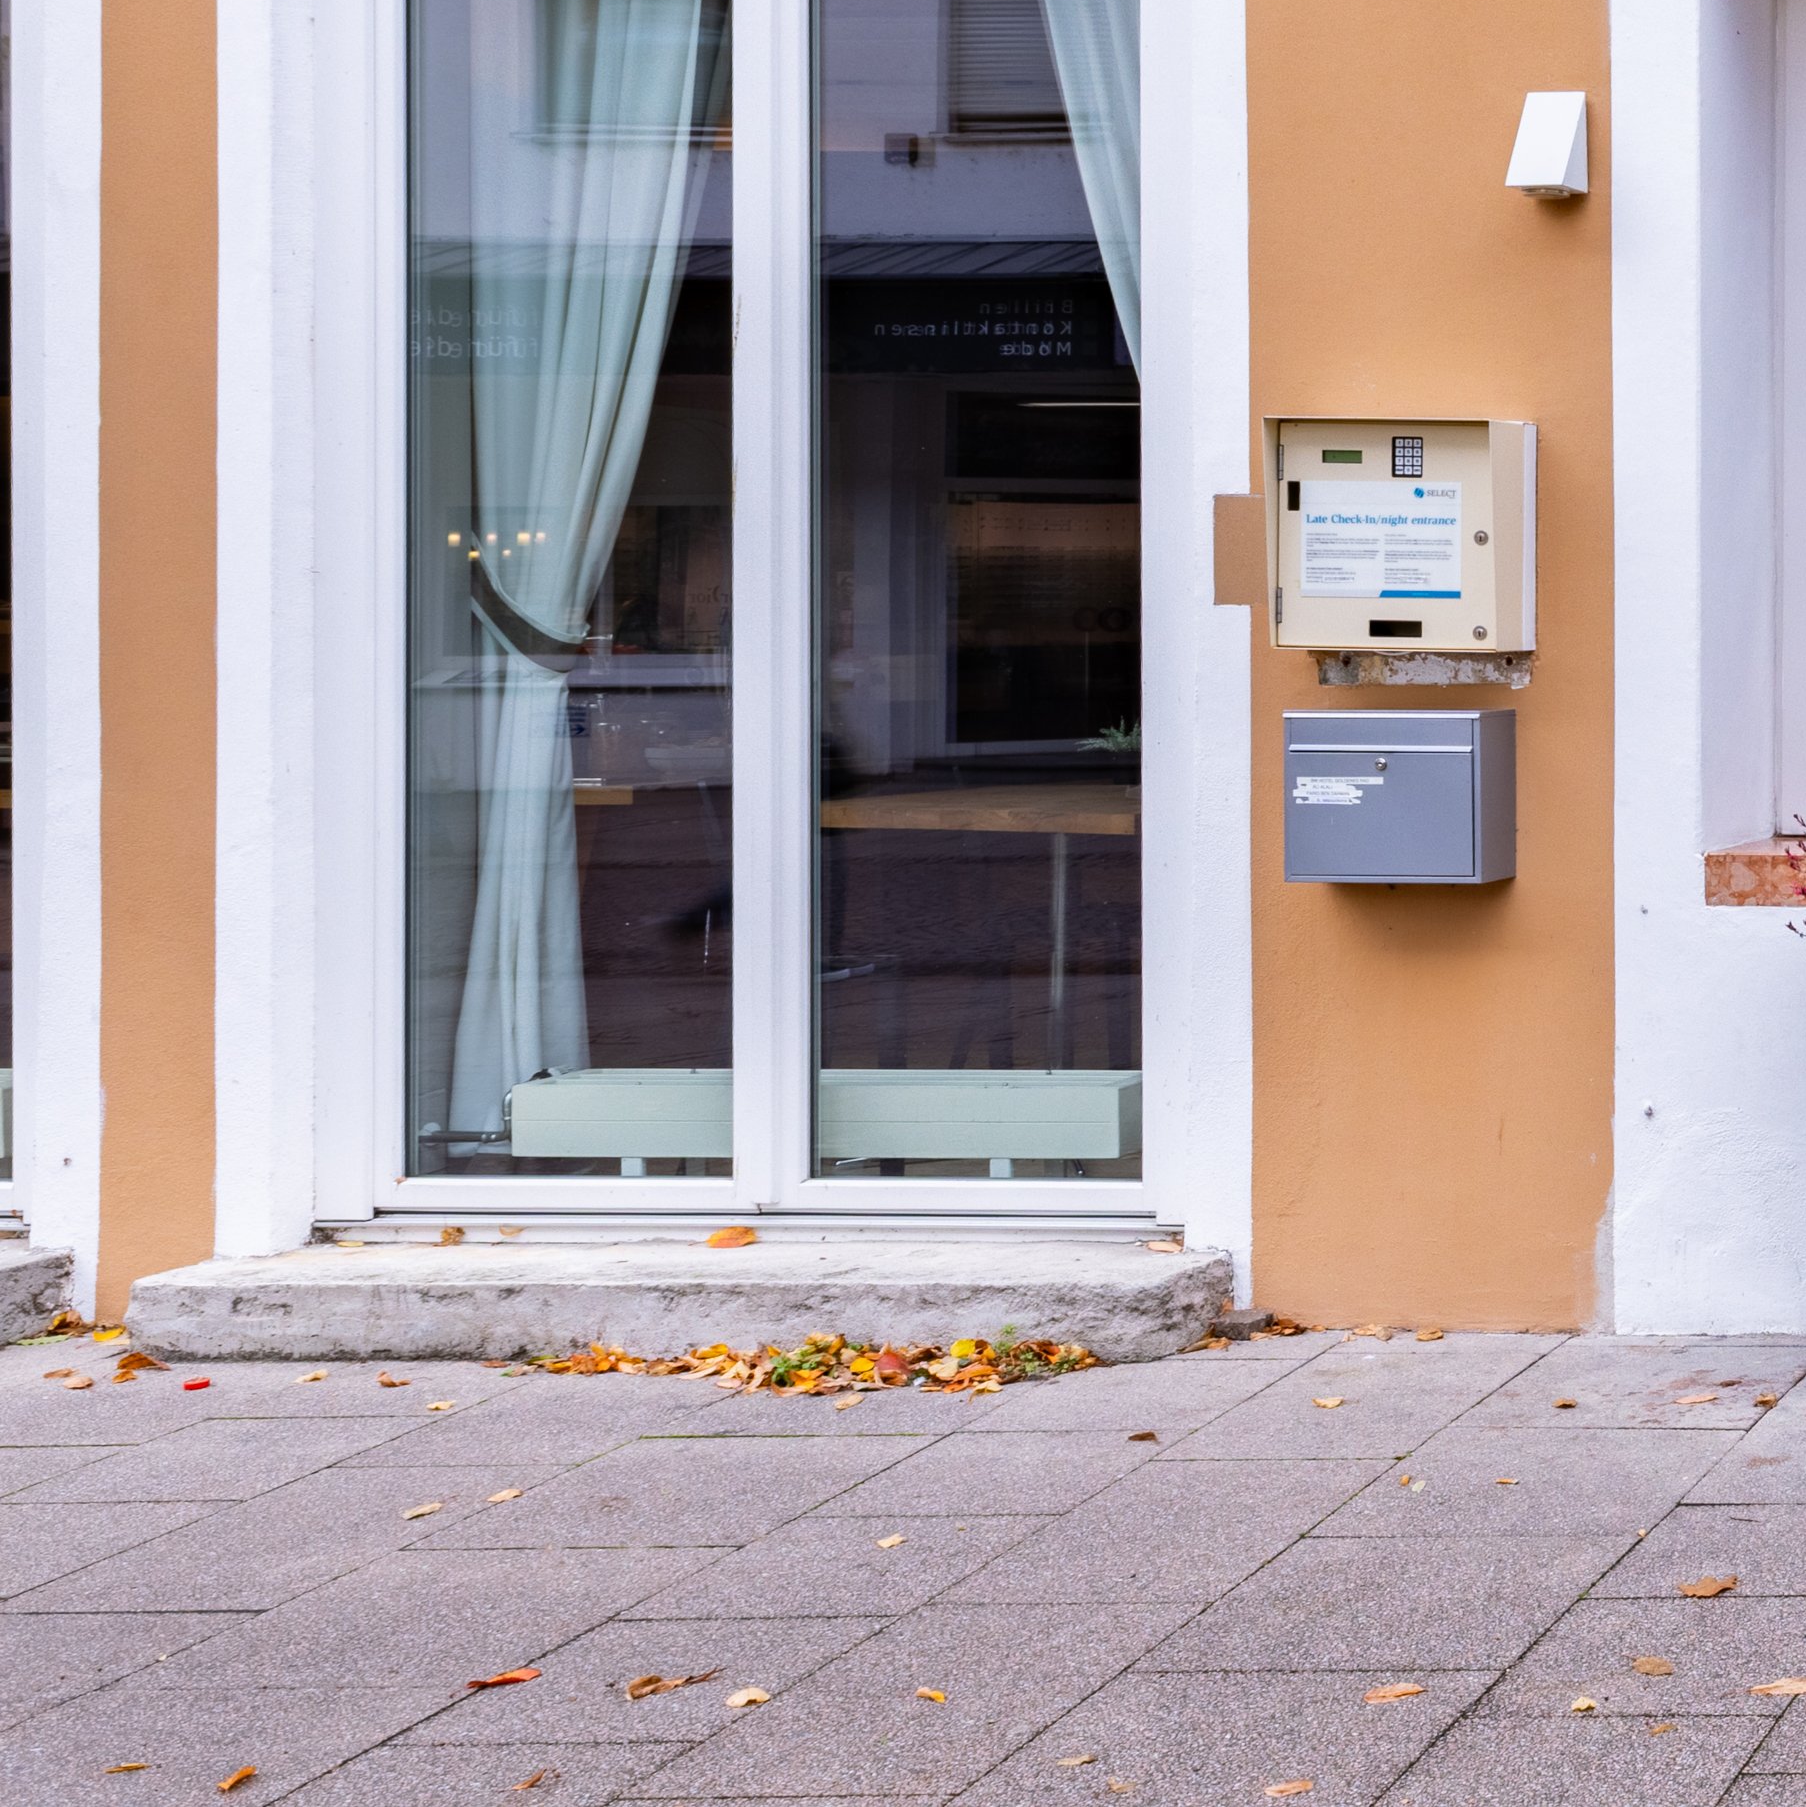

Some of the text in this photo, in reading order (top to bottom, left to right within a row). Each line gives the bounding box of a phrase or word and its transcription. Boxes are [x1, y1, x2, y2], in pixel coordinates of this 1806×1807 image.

[1426, 489, 1457, 497] SELECT
[1306, 514, 1457, 527] Late Check-In/night entrance
